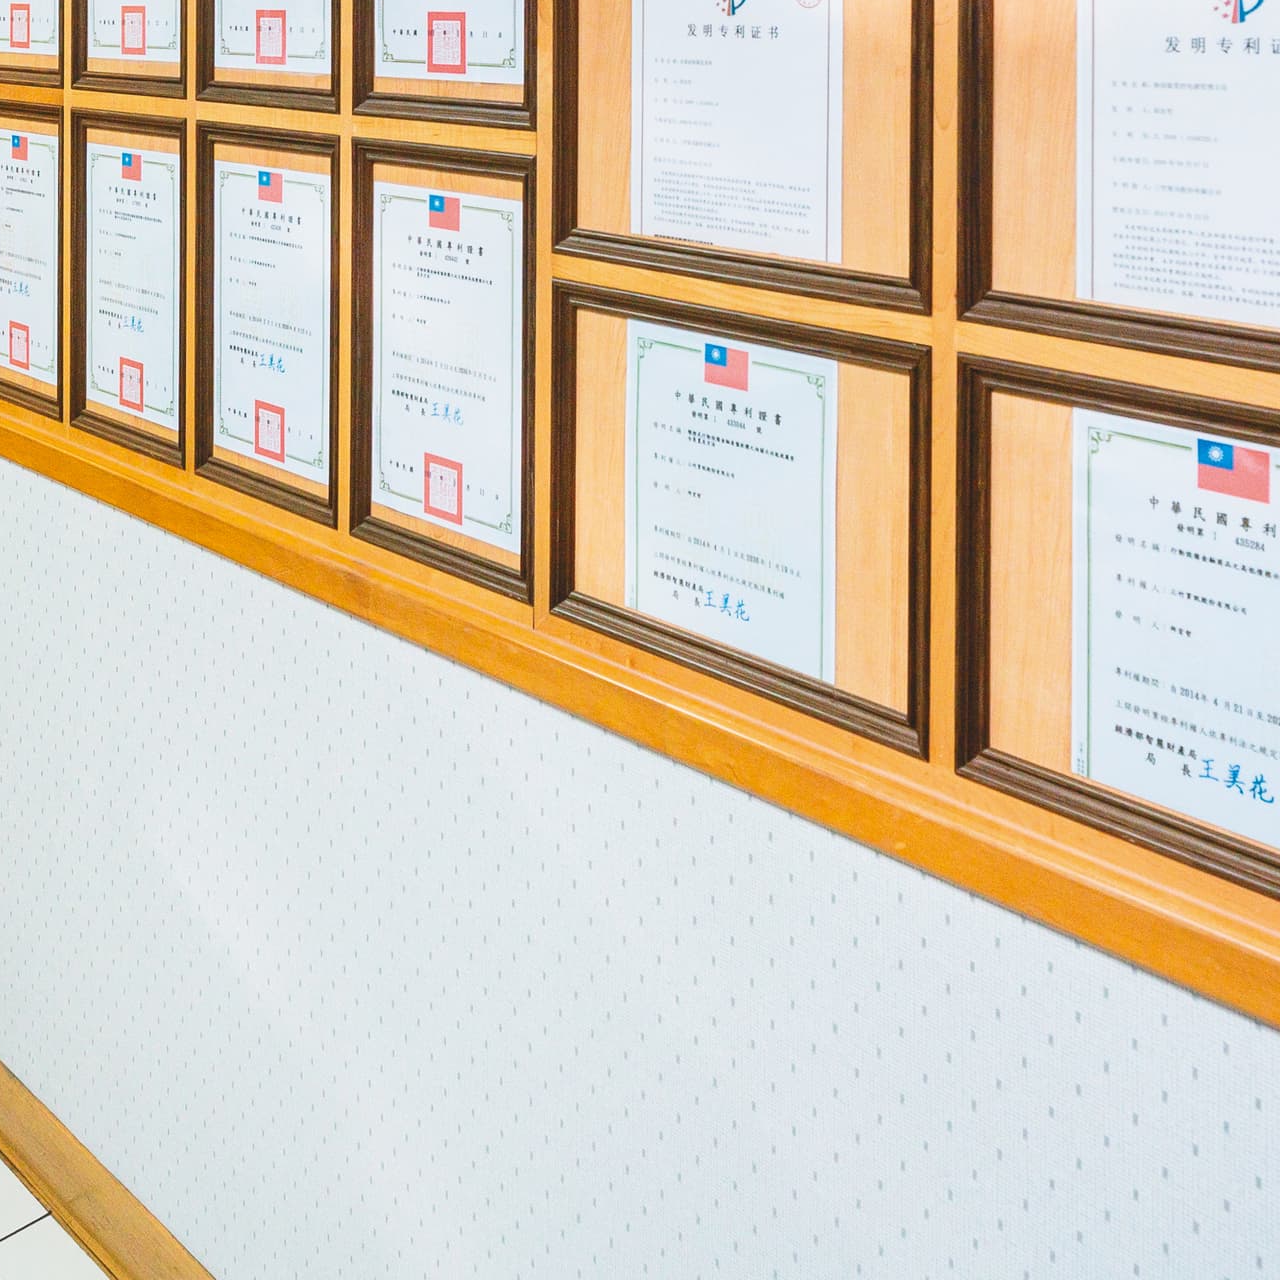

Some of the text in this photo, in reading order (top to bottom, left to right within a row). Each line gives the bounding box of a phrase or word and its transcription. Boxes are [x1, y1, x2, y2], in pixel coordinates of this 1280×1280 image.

[687, 23, 780, 40] 发明专利证书
[675, 390, 782, 426] 中華民國專利證書
[704, 591, 750, 621] 王美花
[1115, 724, 1275, 804] 經濟部智慧財產局 王美花
